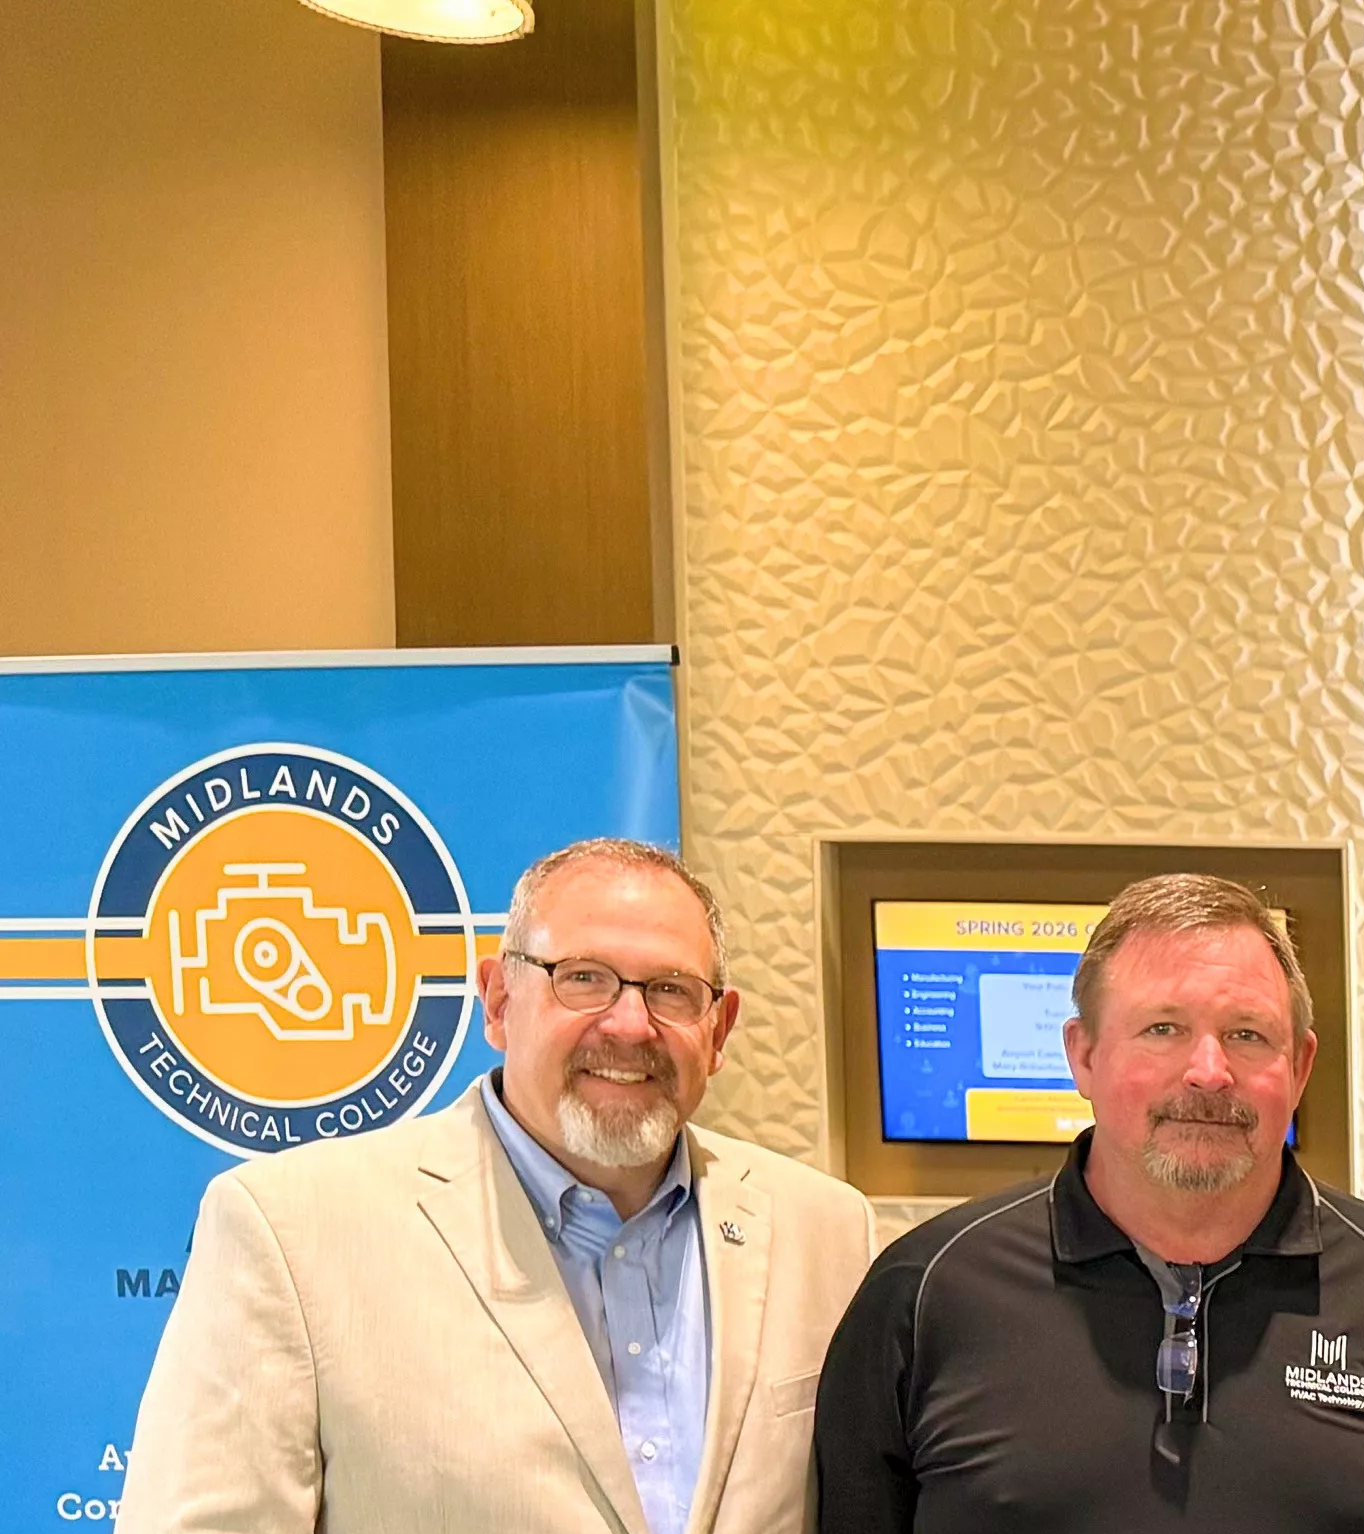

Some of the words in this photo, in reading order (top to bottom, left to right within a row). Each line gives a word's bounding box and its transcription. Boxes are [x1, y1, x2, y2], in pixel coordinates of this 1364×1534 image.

[150, 766, 402, 850] MIDLANDS
[956, 920, 1025, 936] SPRING
[1032, 921, 1078, 937] 2026
[138, 1031, 302, 1143] TECHNICAL
[315, 1030, 438, 1138] COLLEGE
